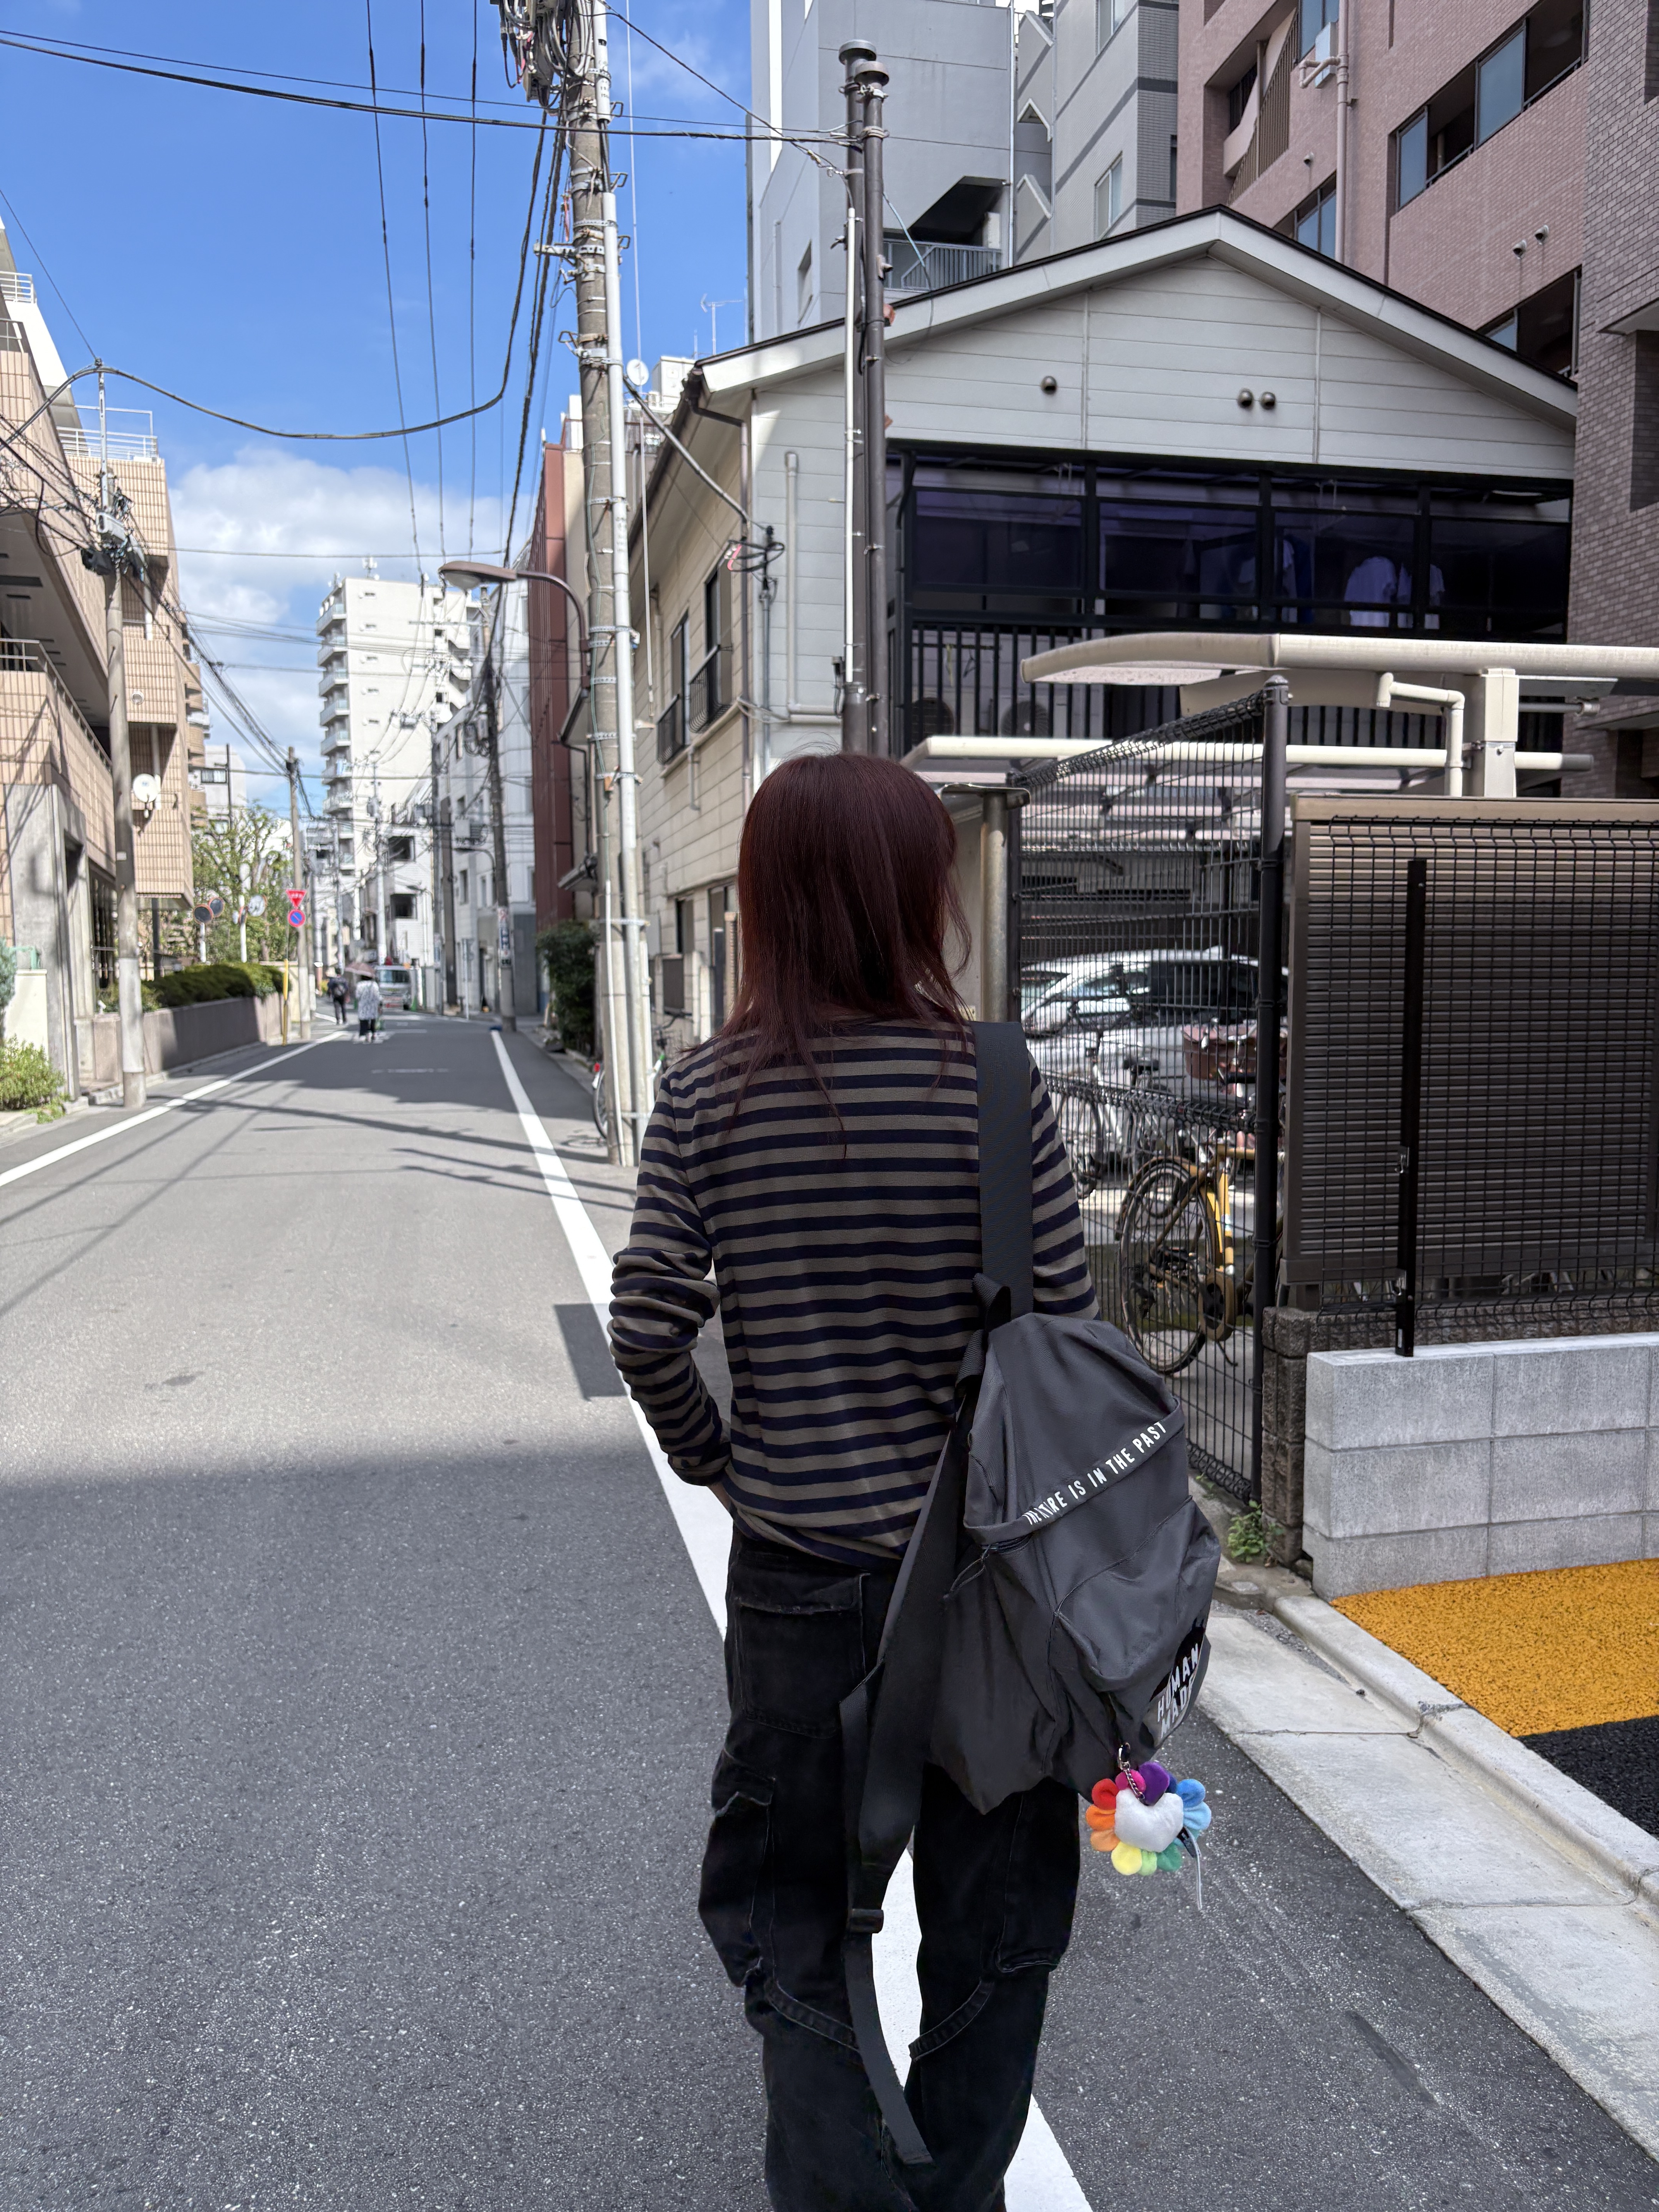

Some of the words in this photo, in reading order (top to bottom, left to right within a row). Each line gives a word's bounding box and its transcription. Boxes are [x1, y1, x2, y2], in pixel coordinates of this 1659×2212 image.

[1068, 1480, 1086, 1499] IS
[1087, 1468, 1107, 1487] IN
[1105, 1448, 1135, 1474] THE
[1132, 1421, 1166, 1453] PAST
[1158, 1643, 1198, 1722] HUMAN
